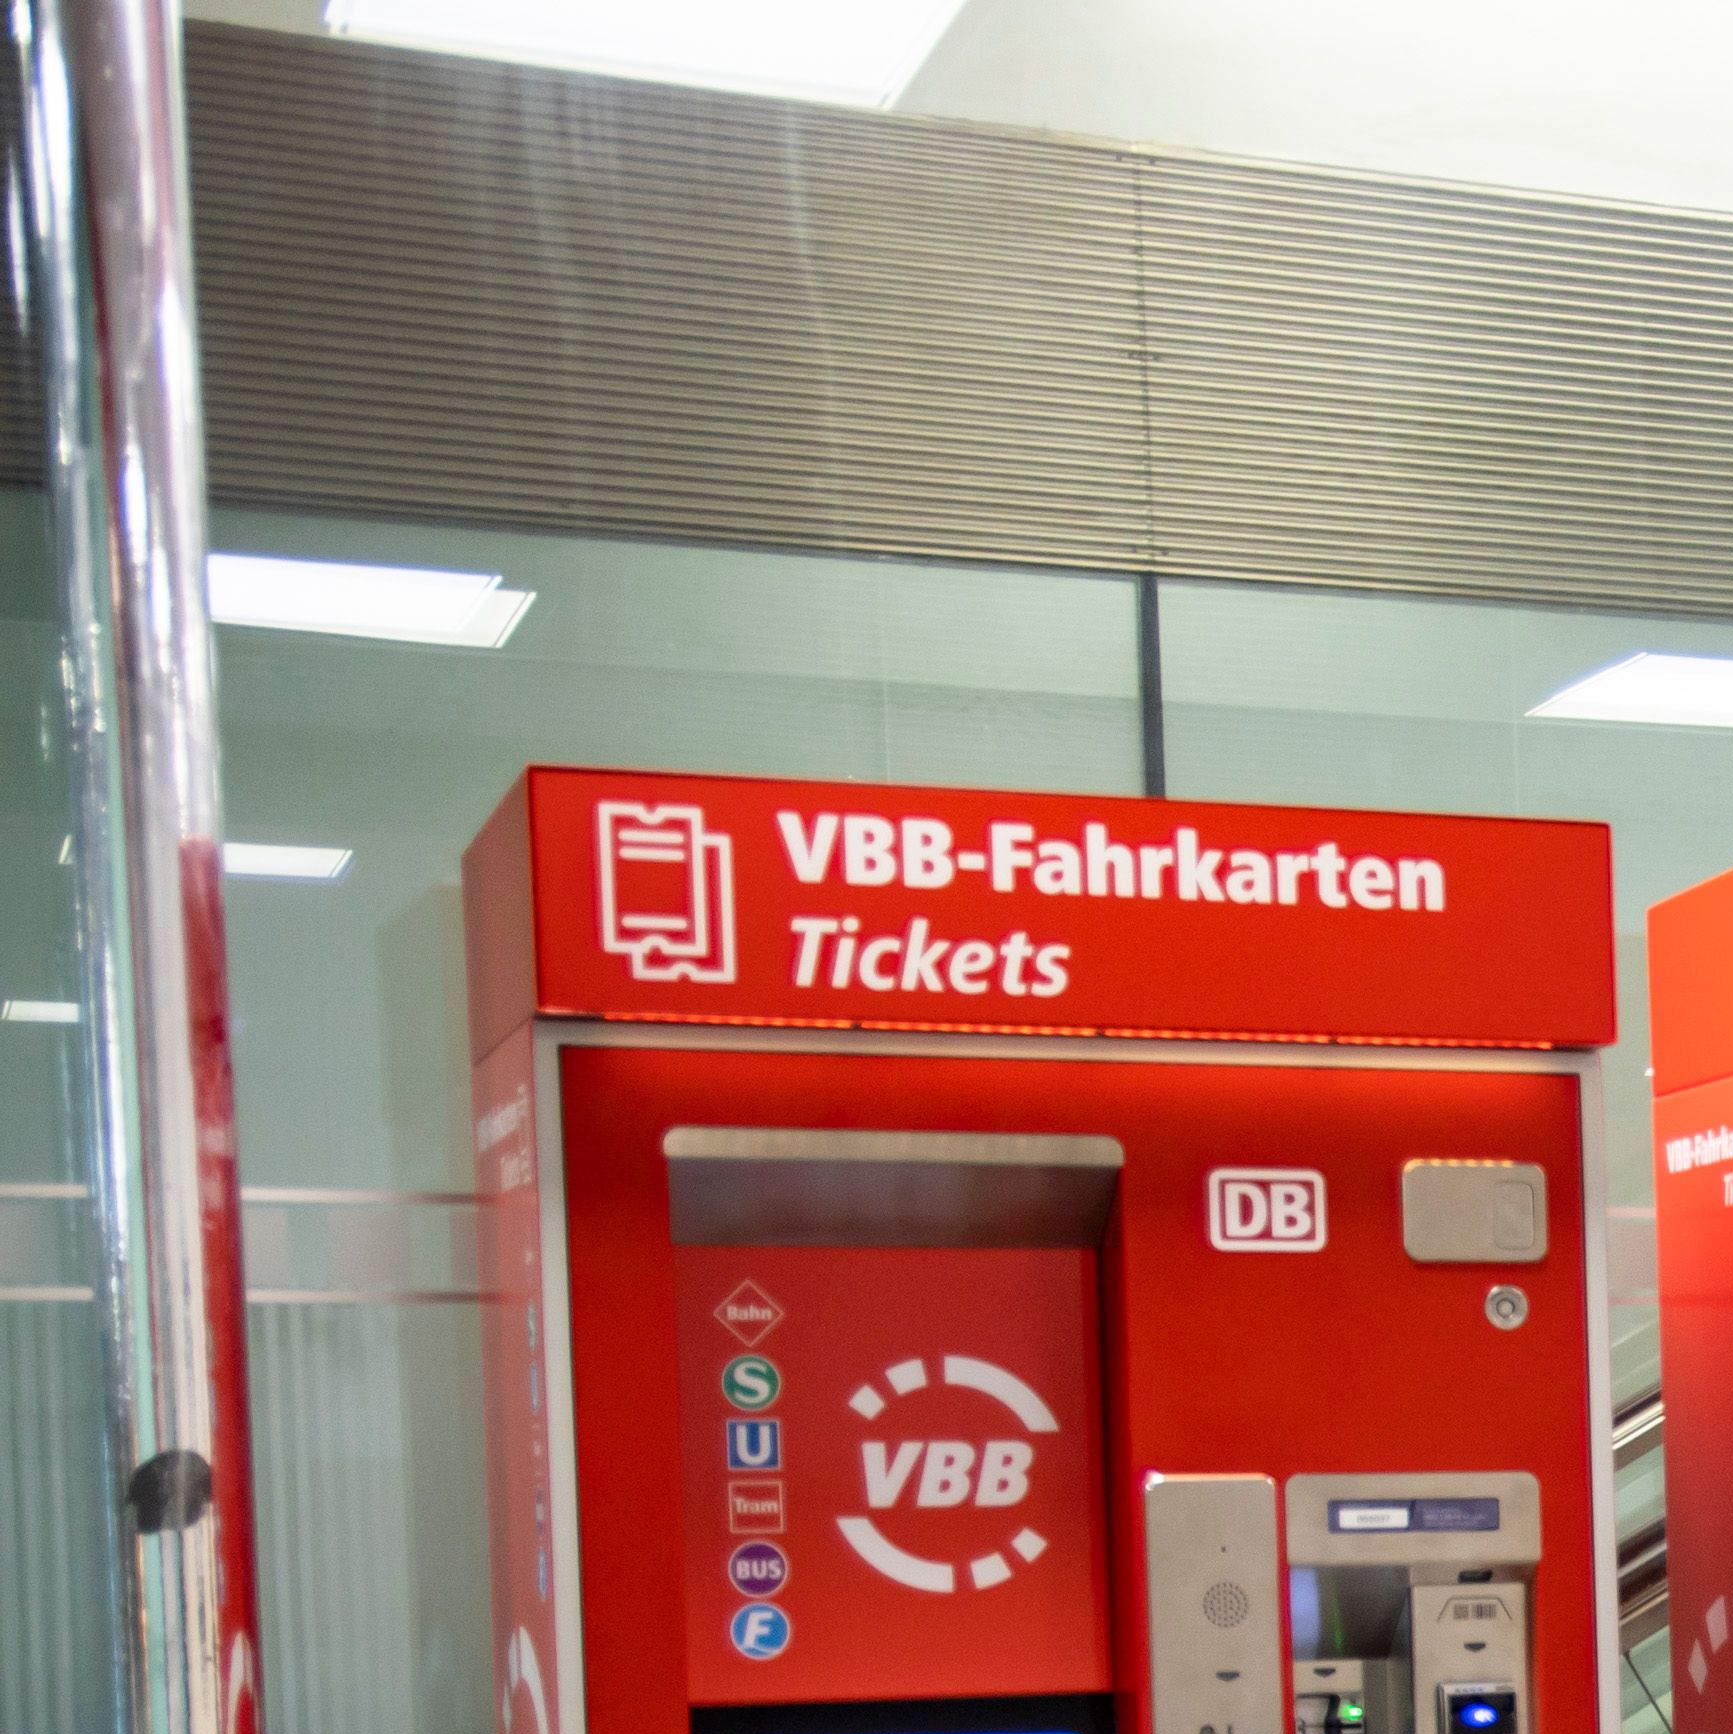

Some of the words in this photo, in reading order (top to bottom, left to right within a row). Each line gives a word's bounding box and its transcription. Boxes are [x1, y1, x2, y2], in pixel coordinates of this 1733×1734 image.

[777, 810, 1446, 912] VBB-Fahrkarten
[790, 915, 1070, 997] Tickets
[1225, 1182, 1312, 1240] DB
[726, 1305, 773, 1323] Bahn
[733, 1362, 770, 1402] S
[736, 1425, 773, 1465] U
[860, 1440, 1034, 1510] VBB
[734, 1498, 779, 1515] Tram
[735, 1562, 783, 1581] BUS
